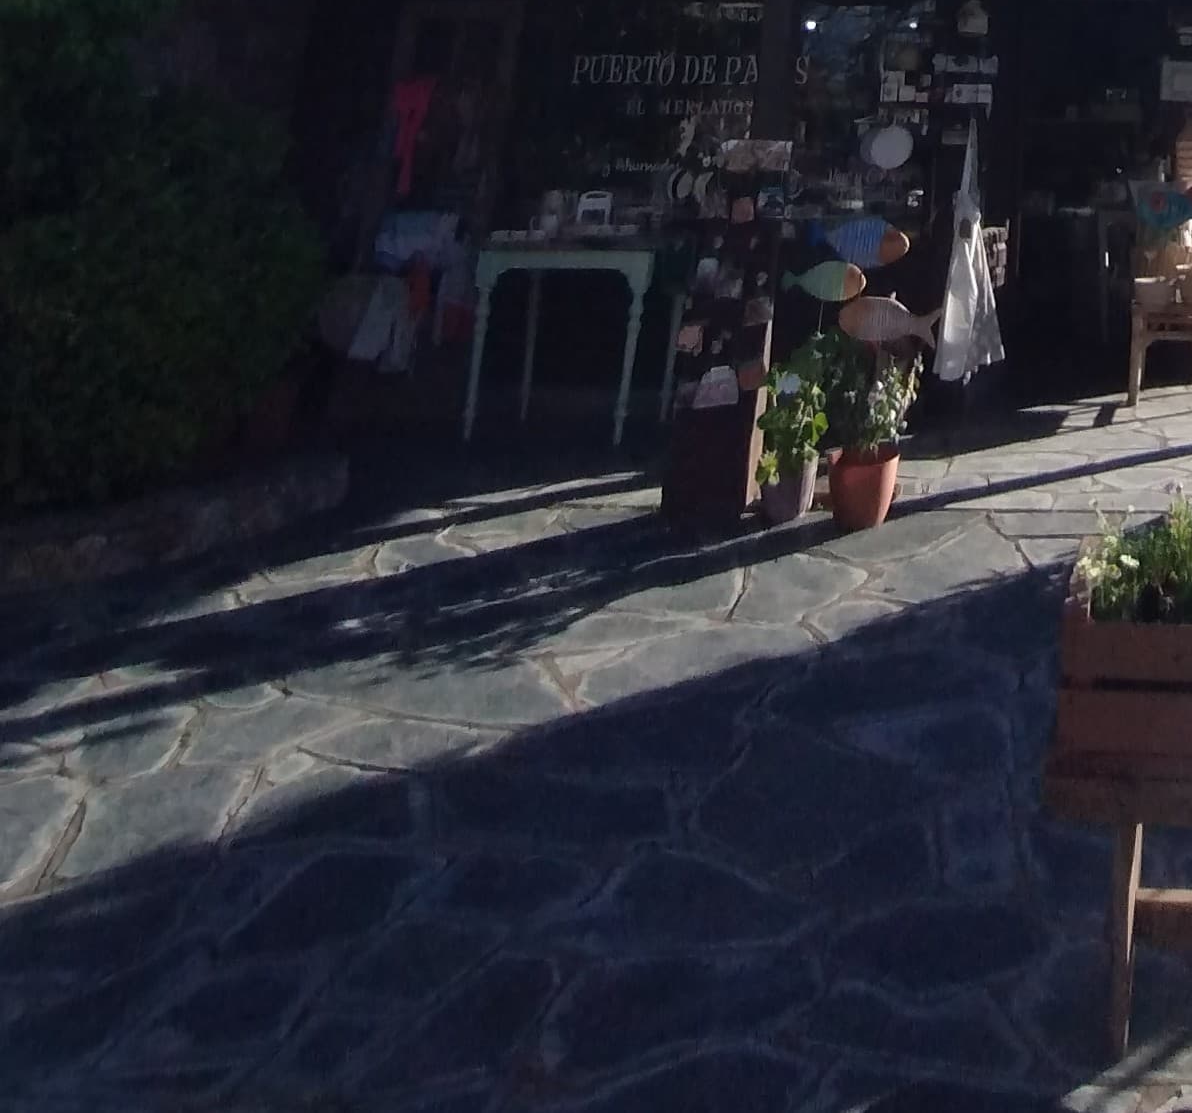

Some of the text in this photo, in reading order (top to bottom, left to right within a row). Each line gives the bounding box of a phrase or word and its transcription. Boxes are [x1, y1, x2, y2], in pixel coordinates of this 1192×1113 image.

[572, 52, 811, 86] PUERTO DE PAS
